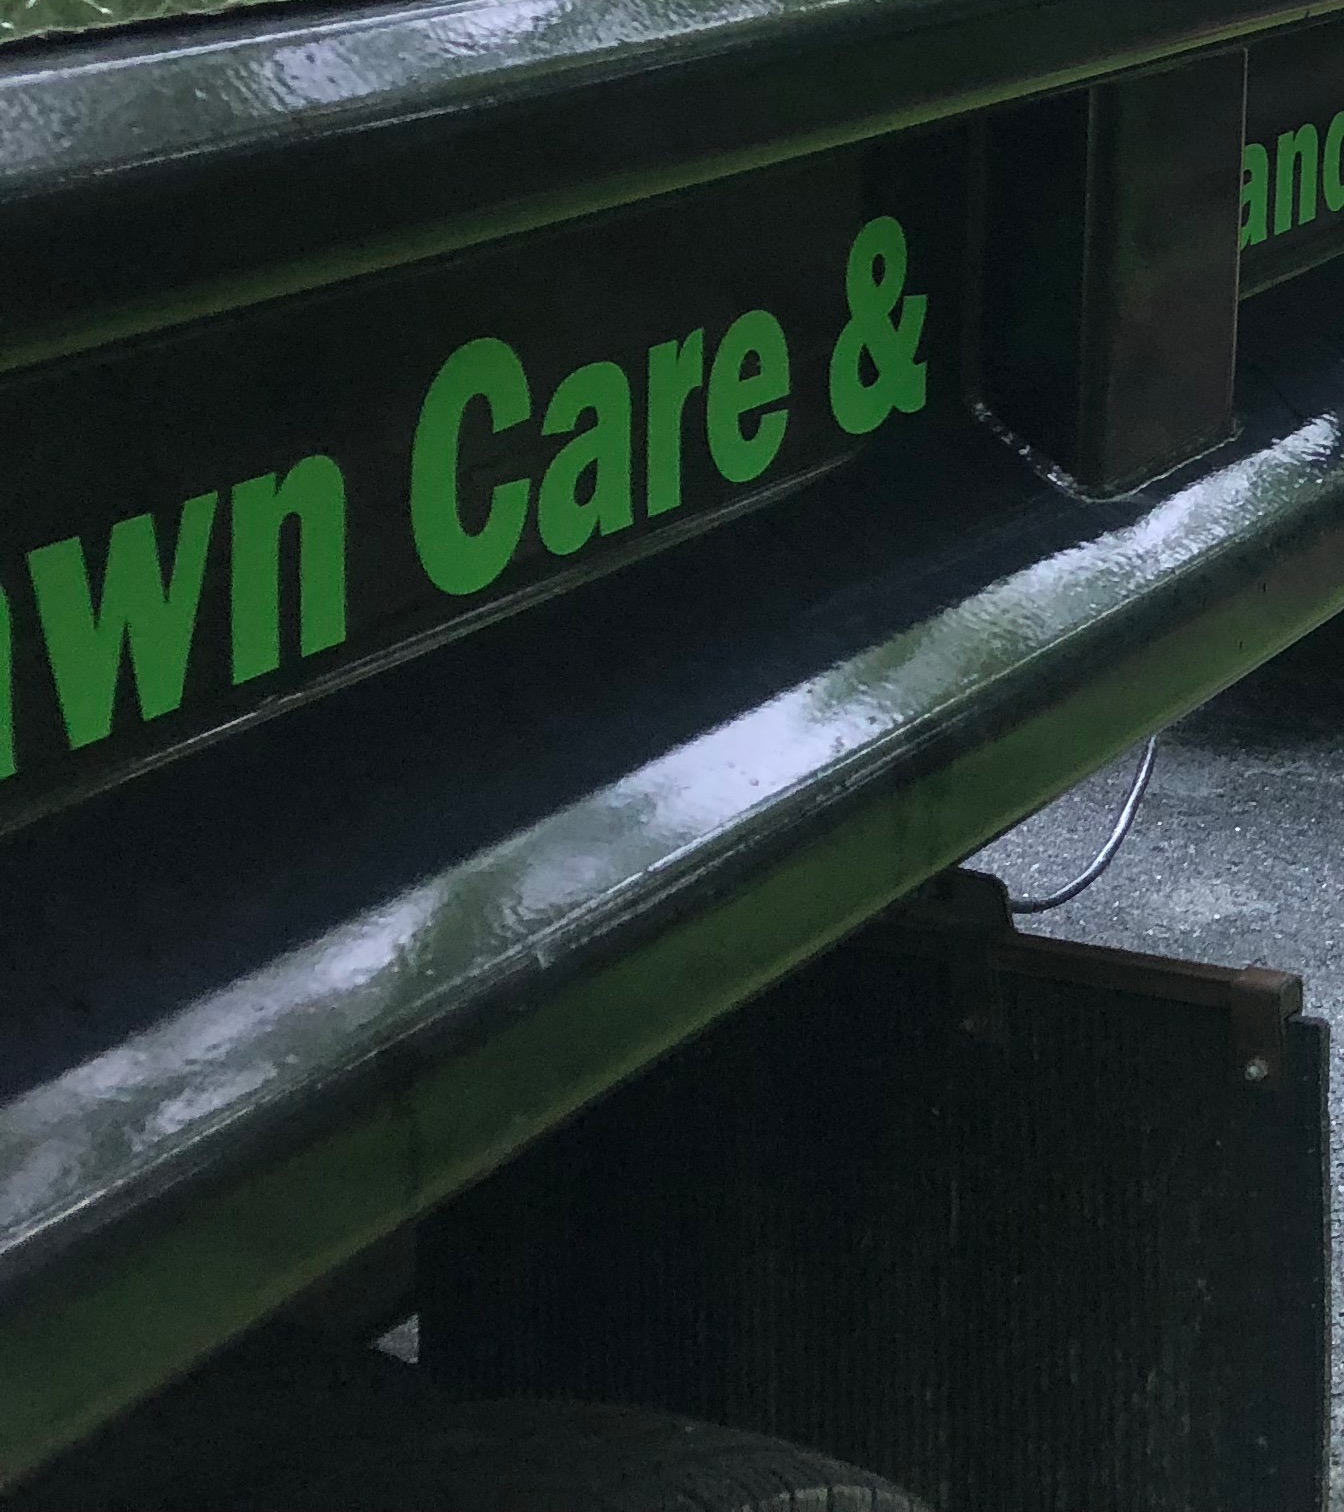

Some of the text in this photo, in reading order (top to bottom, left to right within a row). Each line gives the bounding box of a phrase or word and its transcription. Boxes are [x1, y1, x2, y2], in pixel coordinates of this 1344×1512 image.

[0, 454, 347, 780] wn
[411, 309, 792, 596] Care
[829, 215, 929, 435] &
